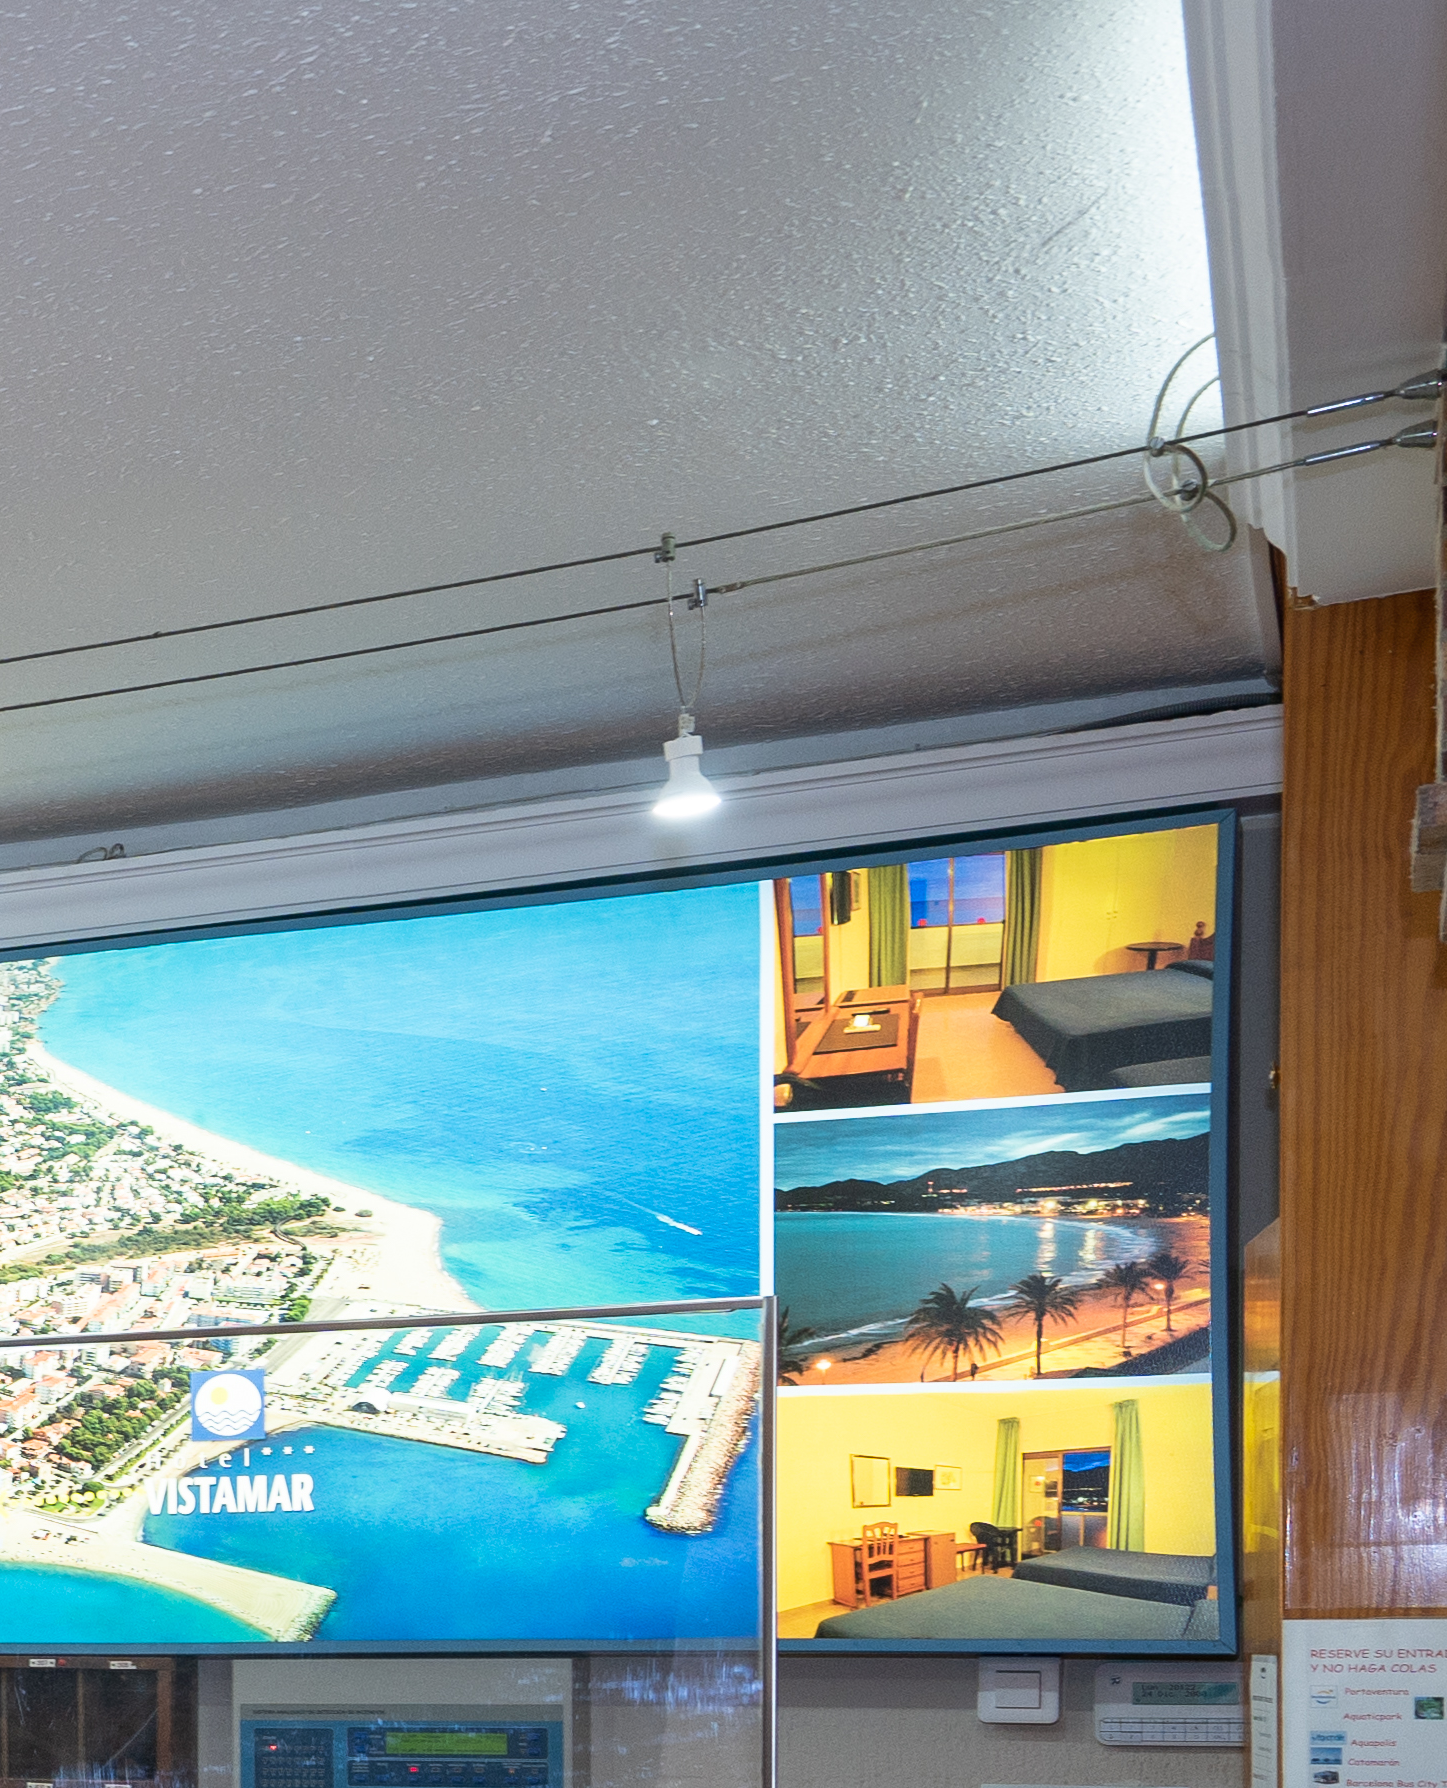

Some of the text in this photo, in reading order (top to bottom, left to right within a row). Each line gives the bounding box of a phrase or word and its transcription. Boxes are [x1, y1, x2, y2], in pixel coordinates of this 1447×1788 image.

[148, 1447, 250, 1470] Hotel
[144, 1473, 315, 1515] VISTAMAR
[1310, 1649, 1370, 1659] RESERVE
[1373, 1649, 1393, 1659] SU
[1310, 1664, 1437, 1673] Y NO HAGA COLAS
[1345, 1687, 1409, 1695] Portaventura
[1343, 1713, 1402, 1722] Aquaticpark
[1346, 1779, 1393, 1788] Barcelona
[1397, 1780, 1414, 1788] Bus
[1417, 1780, 1438, 1788] City
